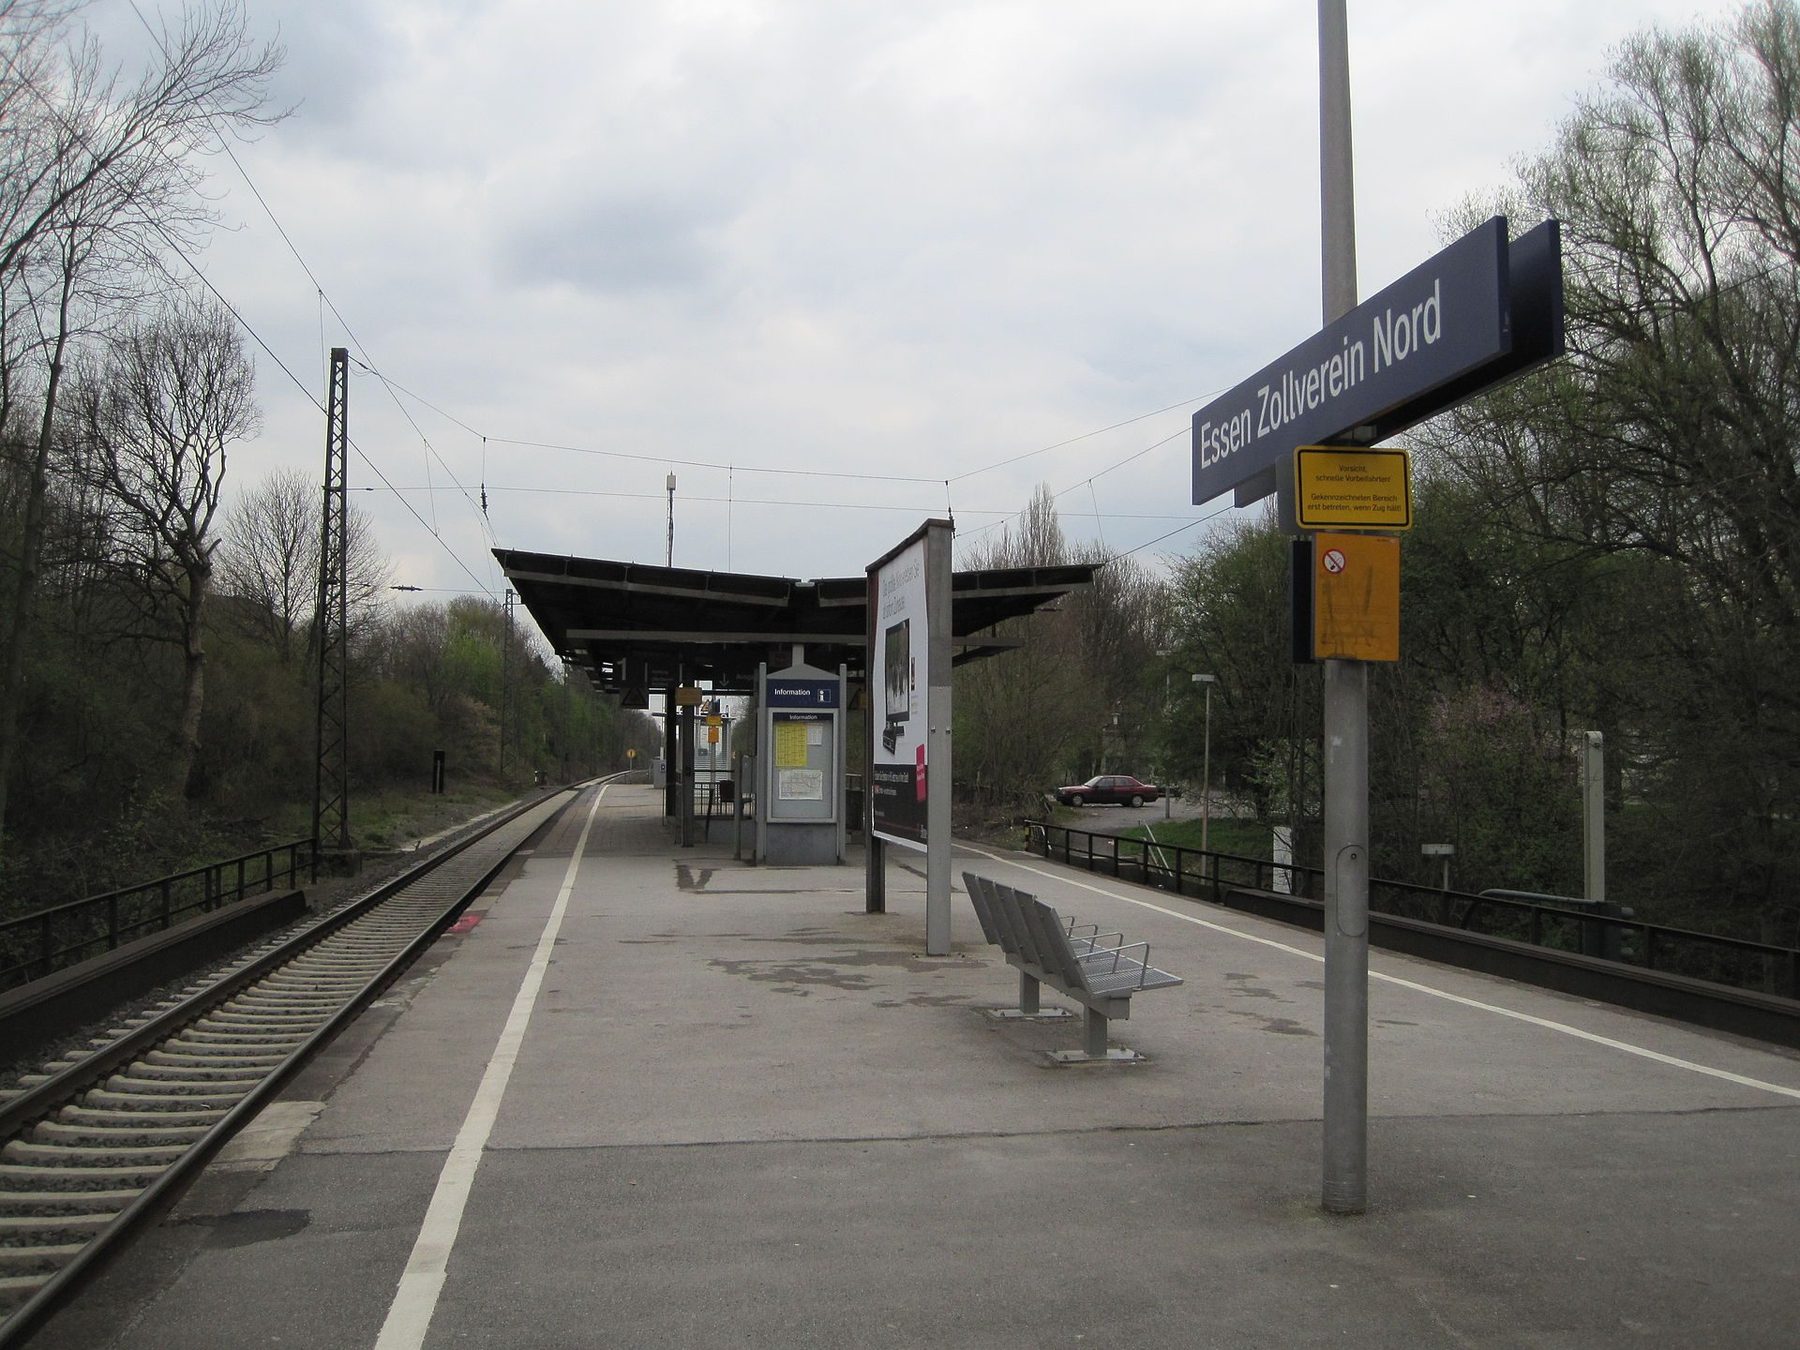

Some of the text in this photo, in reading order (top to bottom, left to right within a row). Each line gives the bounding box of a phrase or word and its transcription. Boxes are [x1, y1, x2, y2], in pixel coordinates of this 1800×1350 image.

[1200, 279, 1441, 470] Essen Zollverein Nord
[1315, 473, 1344, 481] schnelle
[1311, 493, 1397, 502] Gekennzeichneten Bereich
[1307, 503, 1321, 511] erst
[1372, 504, 1385, 513] Zug
[616, 657, 627, 681] 1
[774, 688, 811, 696] Information
